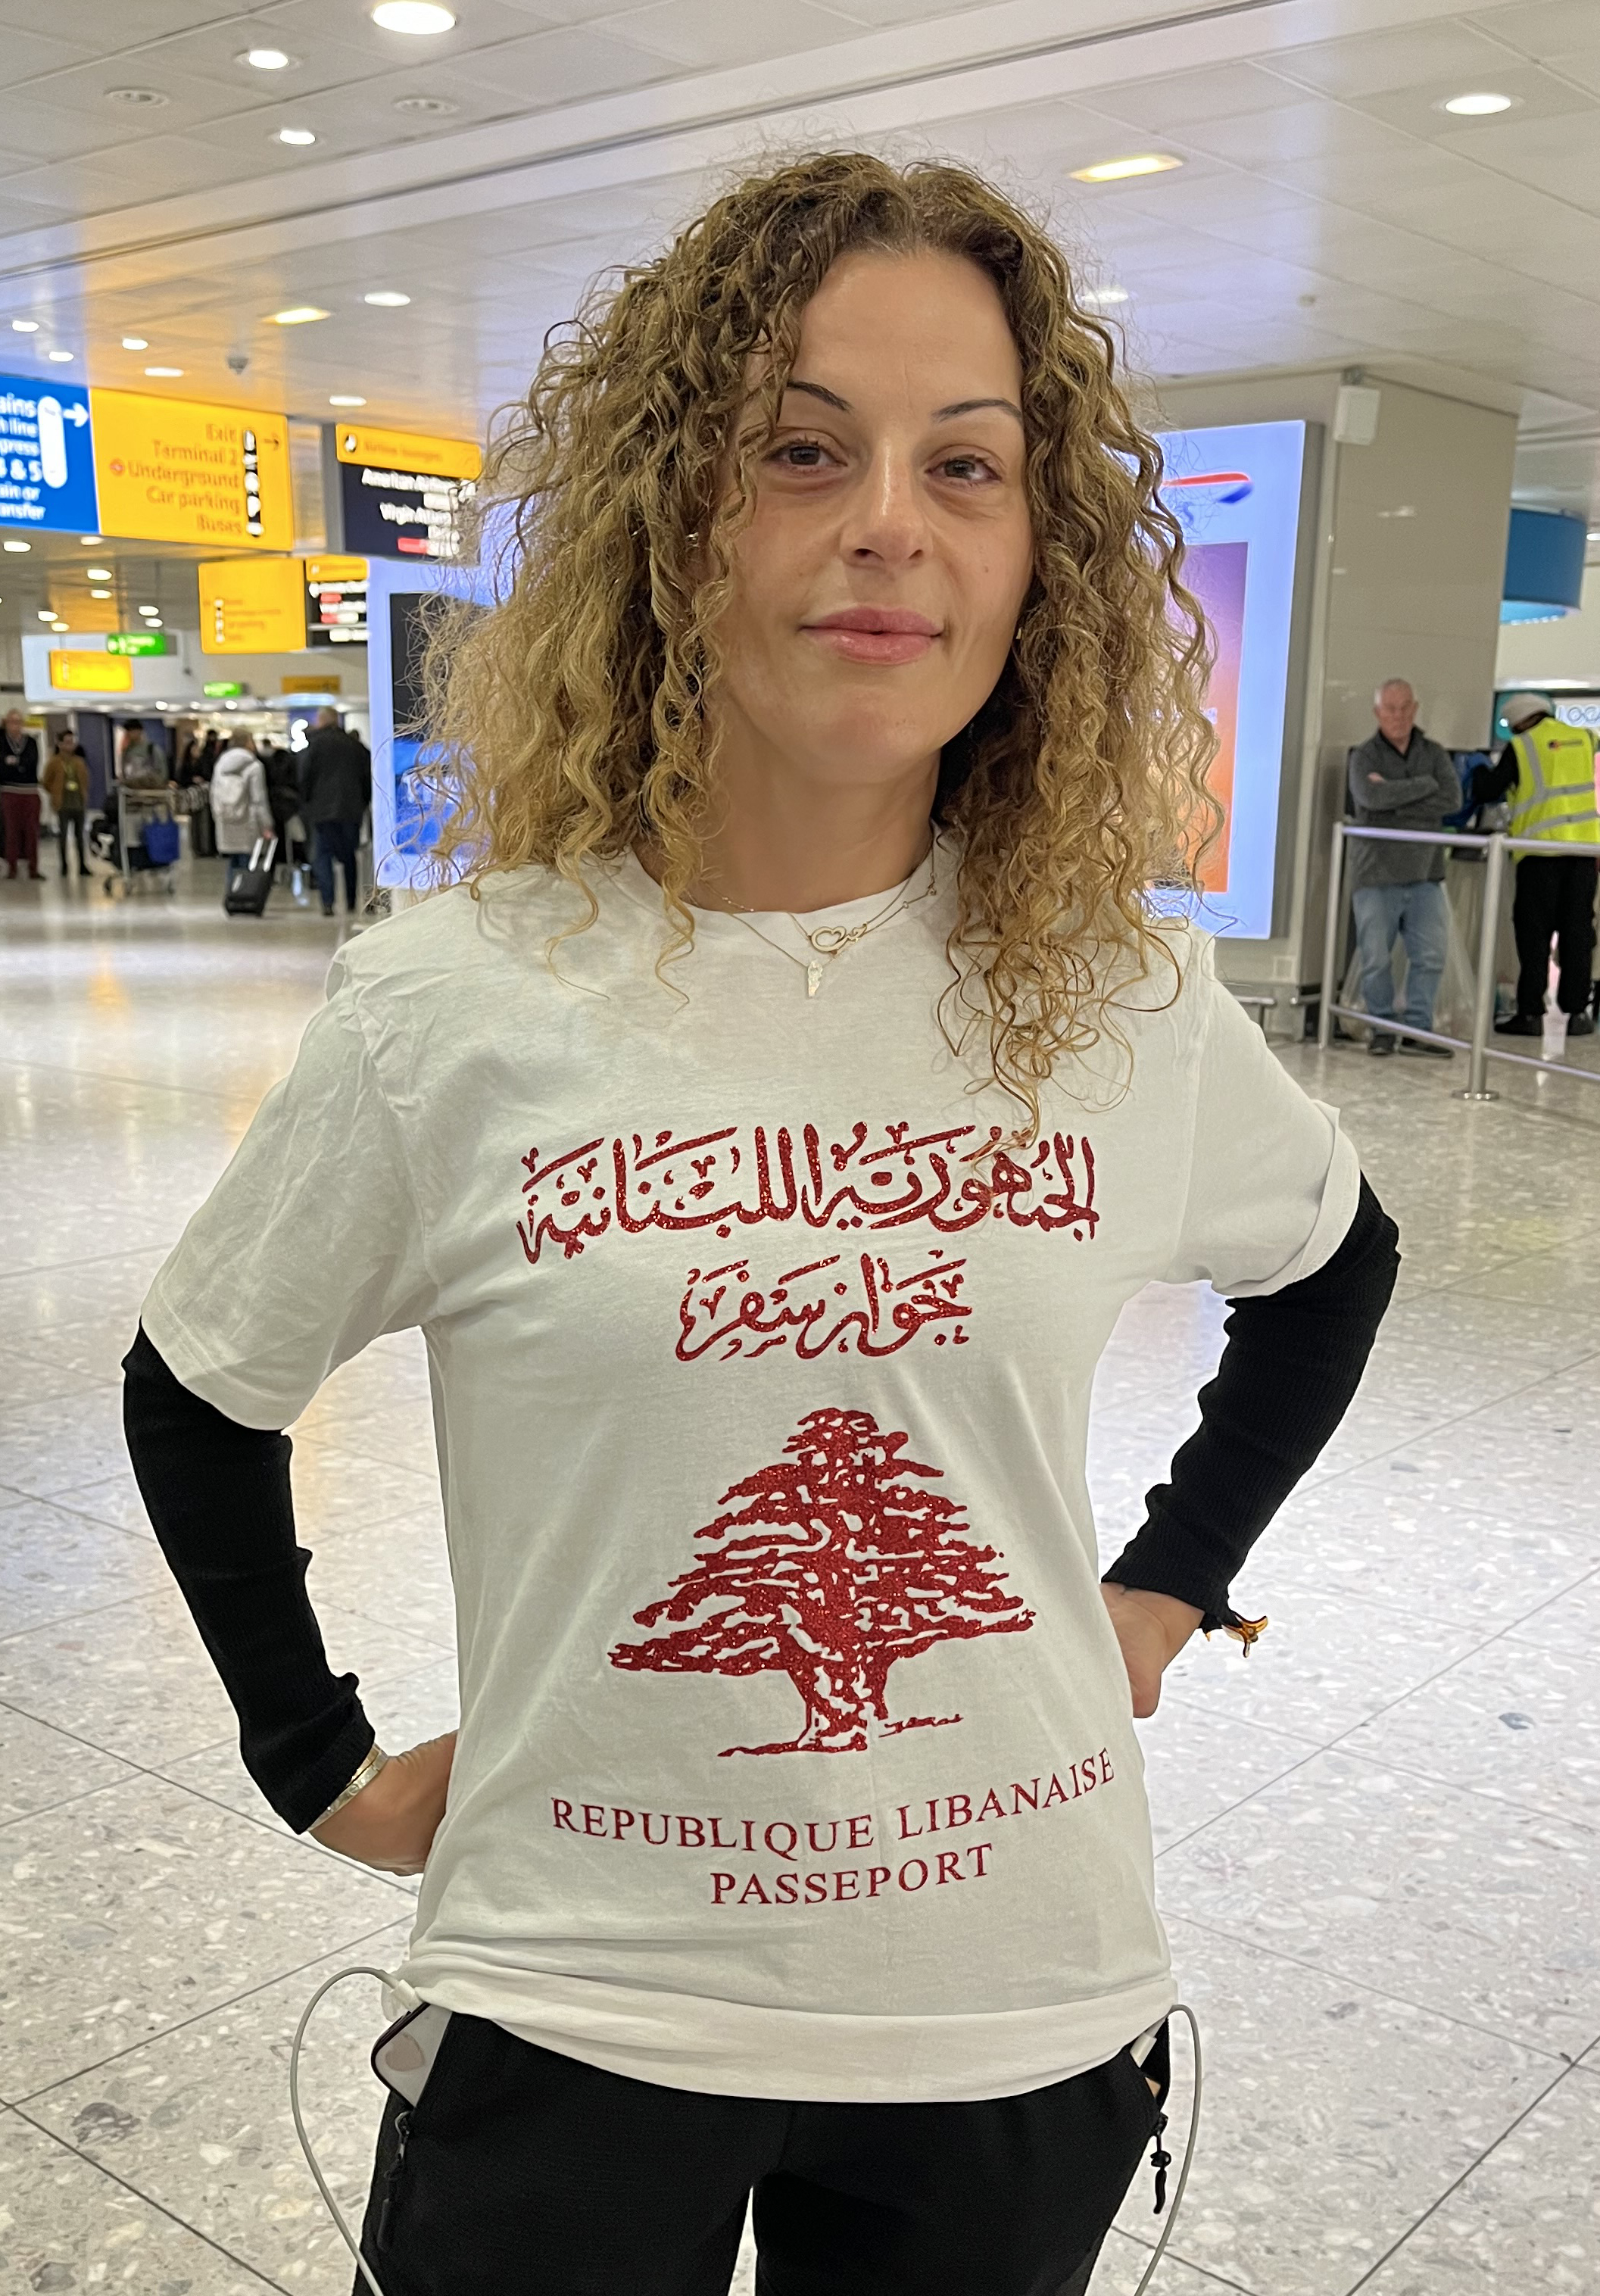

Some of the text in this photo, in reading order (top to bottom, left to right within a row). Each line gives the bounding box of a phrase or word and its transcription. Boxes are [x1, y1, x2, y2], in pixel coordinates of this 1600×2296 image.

[0, 392, 37, 418] ains
[205, 423, 237, 443] Exit
[0, 438, 40, 456] press
[152, 441, 238, 465] Terminal 2
[10, 458, 27, 481] &
[128, 460, 239, 487] Underground
[0, 481, 21, 500] ain
[147, 485, 240, 516] Car parking
[0, 501, 46, 520] ansfer
[197, 515, 241, 535] Buses
[551, 1746, 1115, 1861] REPUBLIQUE LIBANAISE
[710, 1842, 993, 1906] PASSEPORT
